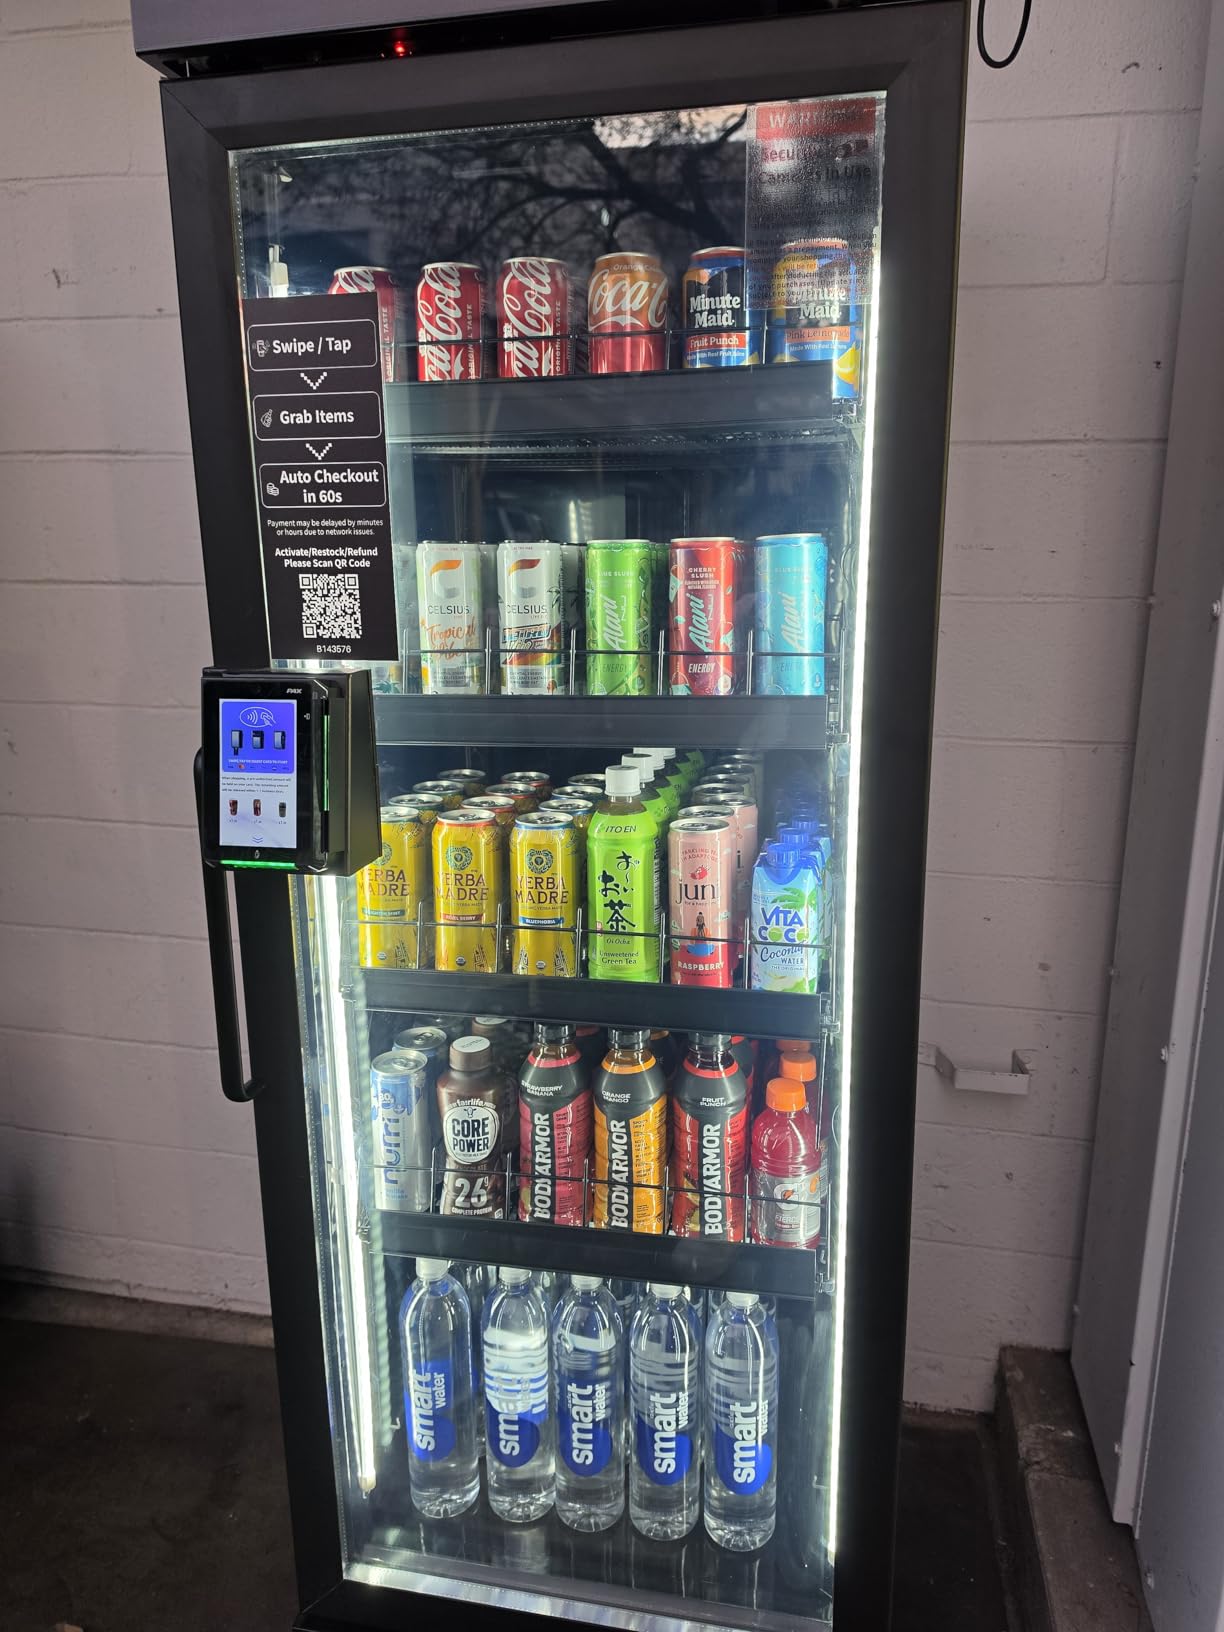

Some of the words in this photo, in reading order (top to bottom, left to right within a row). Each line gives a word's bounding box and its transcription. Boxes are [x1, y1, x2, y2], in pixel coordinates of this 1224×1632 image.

[588, 269, 668, 328] Coca-C
[690, 293, 741, 313] Minute
[690, 335, 708, 348] Fruit
[710, 335, 739, 346] Punch
[787, 330, 805, 340] Pink
[273, 338, 315, 356] Swipe
[318, 337, 323, 355] /
[326, 337, 352, 354] Tap
[280, 409, 312, 425] Grab
[315, 410, 354, 424] Items
[280, 470, 311, 484] Auto
[314, 469, 379, 483] Checkout
[303, 489, 316, 503] in
[319, 490, 343, 503] 60s
[267, 519, 296, 529] Payment
[296, 520, 310, 528] may
[311, 519, 320, 527] be
[321, 519, 346, 528] delayed
[347, 519, 355, 527] by
[357, 518, 383, 526] minutes
[285, 528, 303, 536] hours
[304, 528, 316, 536] due
[275, 547, 378, 558] Activate/Restock/Refund
[284, 558, 312, 568] Please
[313, 558, 333, 568] Scan
[335, 558, 347, 569] QR
[349, 558, 370, 567] Code
[428, 605, 470, 615] CELSIUS
[506, 604, 548, 614] CELSIUS
[600, 593, 627, 651] Alani
[686, 593, 715, 652] Alani
[778, 591, 806, 652] Alani
[427, 616, 476, 647] Tropical
[316, 645, 351, 654] B143576
[602, 663, 628, 673] ENERGY
[688, 663, 715, 673] ENERGY
[605, 825, 623, 834] ITO
[623, 824, 637, 832] EN
[360, 869, 406, 883] YERBA
[438, 872, 486, 887] YERBA
[516, 876, 566, 889] YERBA
[358, 883, 410, 897] MADRE
[436, 887, 489, 901] MADRE
[515, 890, 569, 904] MADRE
[761, 906, 804, 927] VITA
[758, 926, 809, 943] COCO
[599, 950, 639, 958] Unsweetened
[761, 945, 804, 962] Coconut
[677, 961, 725, 971] RASPBERRY
[521, 1080, 563, 1092] STRAWBERRY
[526, 1088, 554, 1097] BANANA
[602, 1090, 631, 1099] ORANGE
[452, 1117, 489, 1138] CORE
[383, 1117, 401, 1185] nurri
[453, 1137, 489, 1153] POWER
[452, 1207, 473, 1216] COMPLETE
[474, 1206, 493, 1215] PROTEIN
[433, 1372, 446, 1409] water
[595, 1383, 607, 1421] water
[411, 1369, 436, 1451] smart
[676, 1391, 689, 1429] water
[567, 1383, 594, 1466] smart
[757, 1399, 769, 1437] water
[650, 1392, 677, 1474] smart
[730, 1402, 757, 1484] smart
